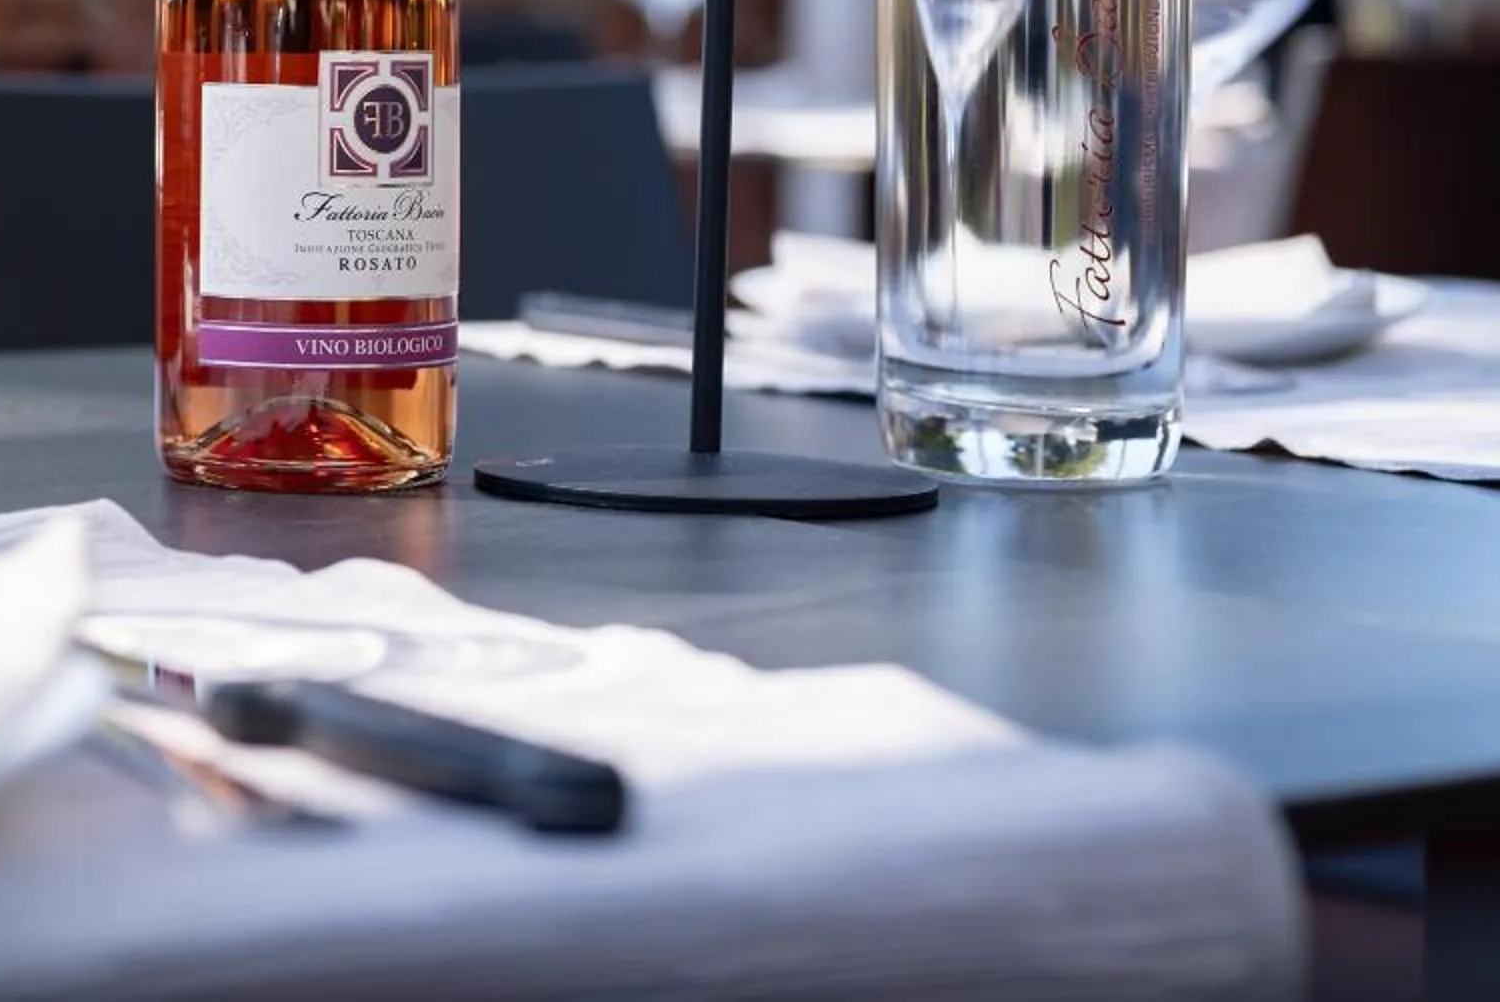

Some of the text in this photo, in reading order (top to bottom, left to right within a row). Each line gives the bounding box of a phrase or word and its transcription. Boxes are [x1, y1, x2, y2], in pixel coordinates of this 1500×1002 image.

[294, 191, 388, 222] Fattoria
[347, 229, 415, 241] TOSCANA
[339, 256, 417, 271] ROSATO
[295, 334, 443, 355] VINO BIOLOGICO
